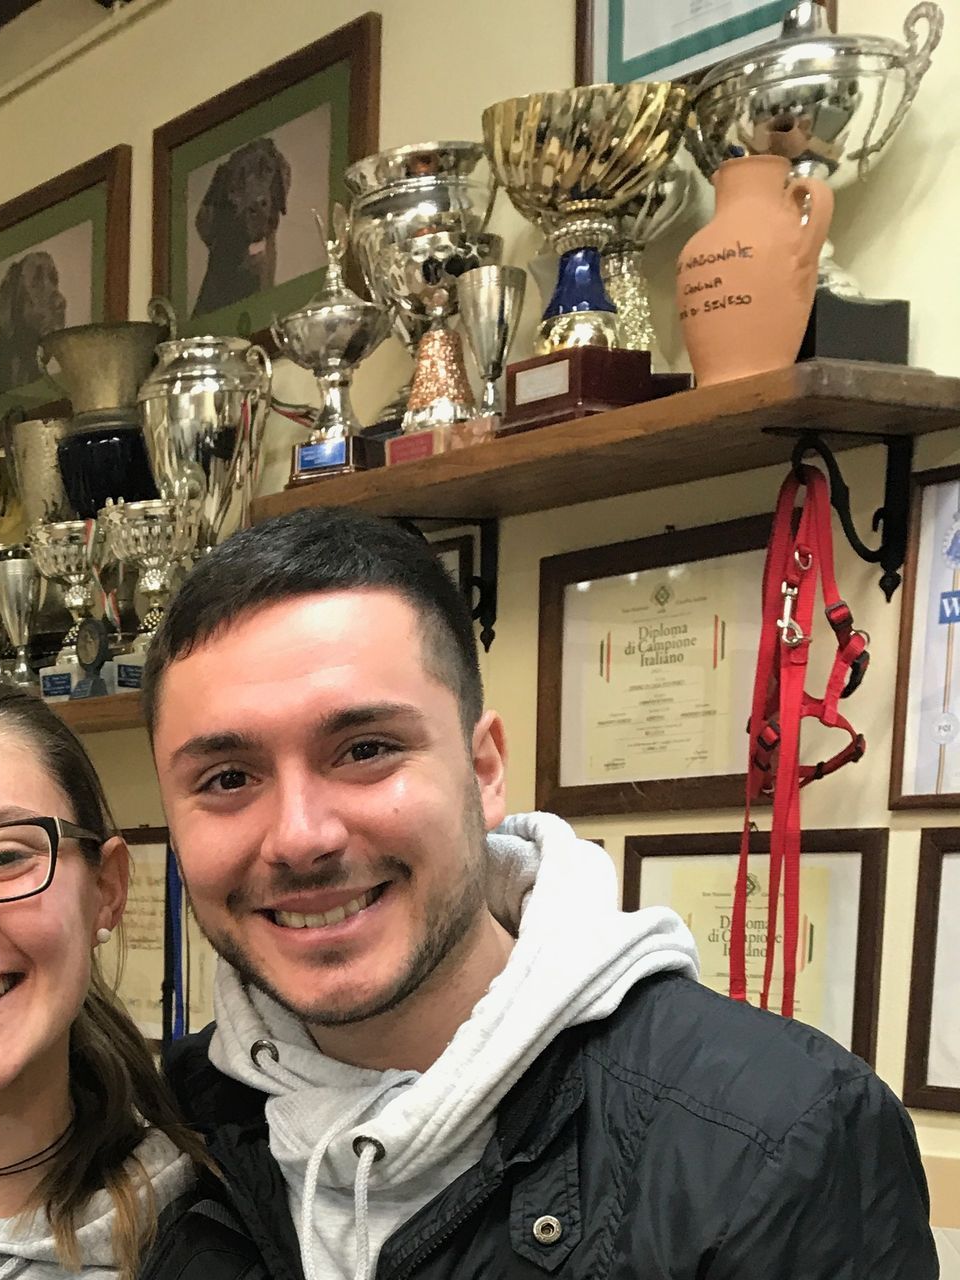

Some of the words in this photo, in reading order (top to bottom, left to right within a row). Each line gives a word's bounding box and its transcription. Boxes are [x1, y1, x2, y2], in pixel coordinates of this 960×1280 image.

[638, 622, 688, 641] Diploma
[624, 642, 636, 655] di
[638, 637, 697, 653] Campione
[640, 652, 684, 667] Italiano
[708, 928, 720, 942] di
